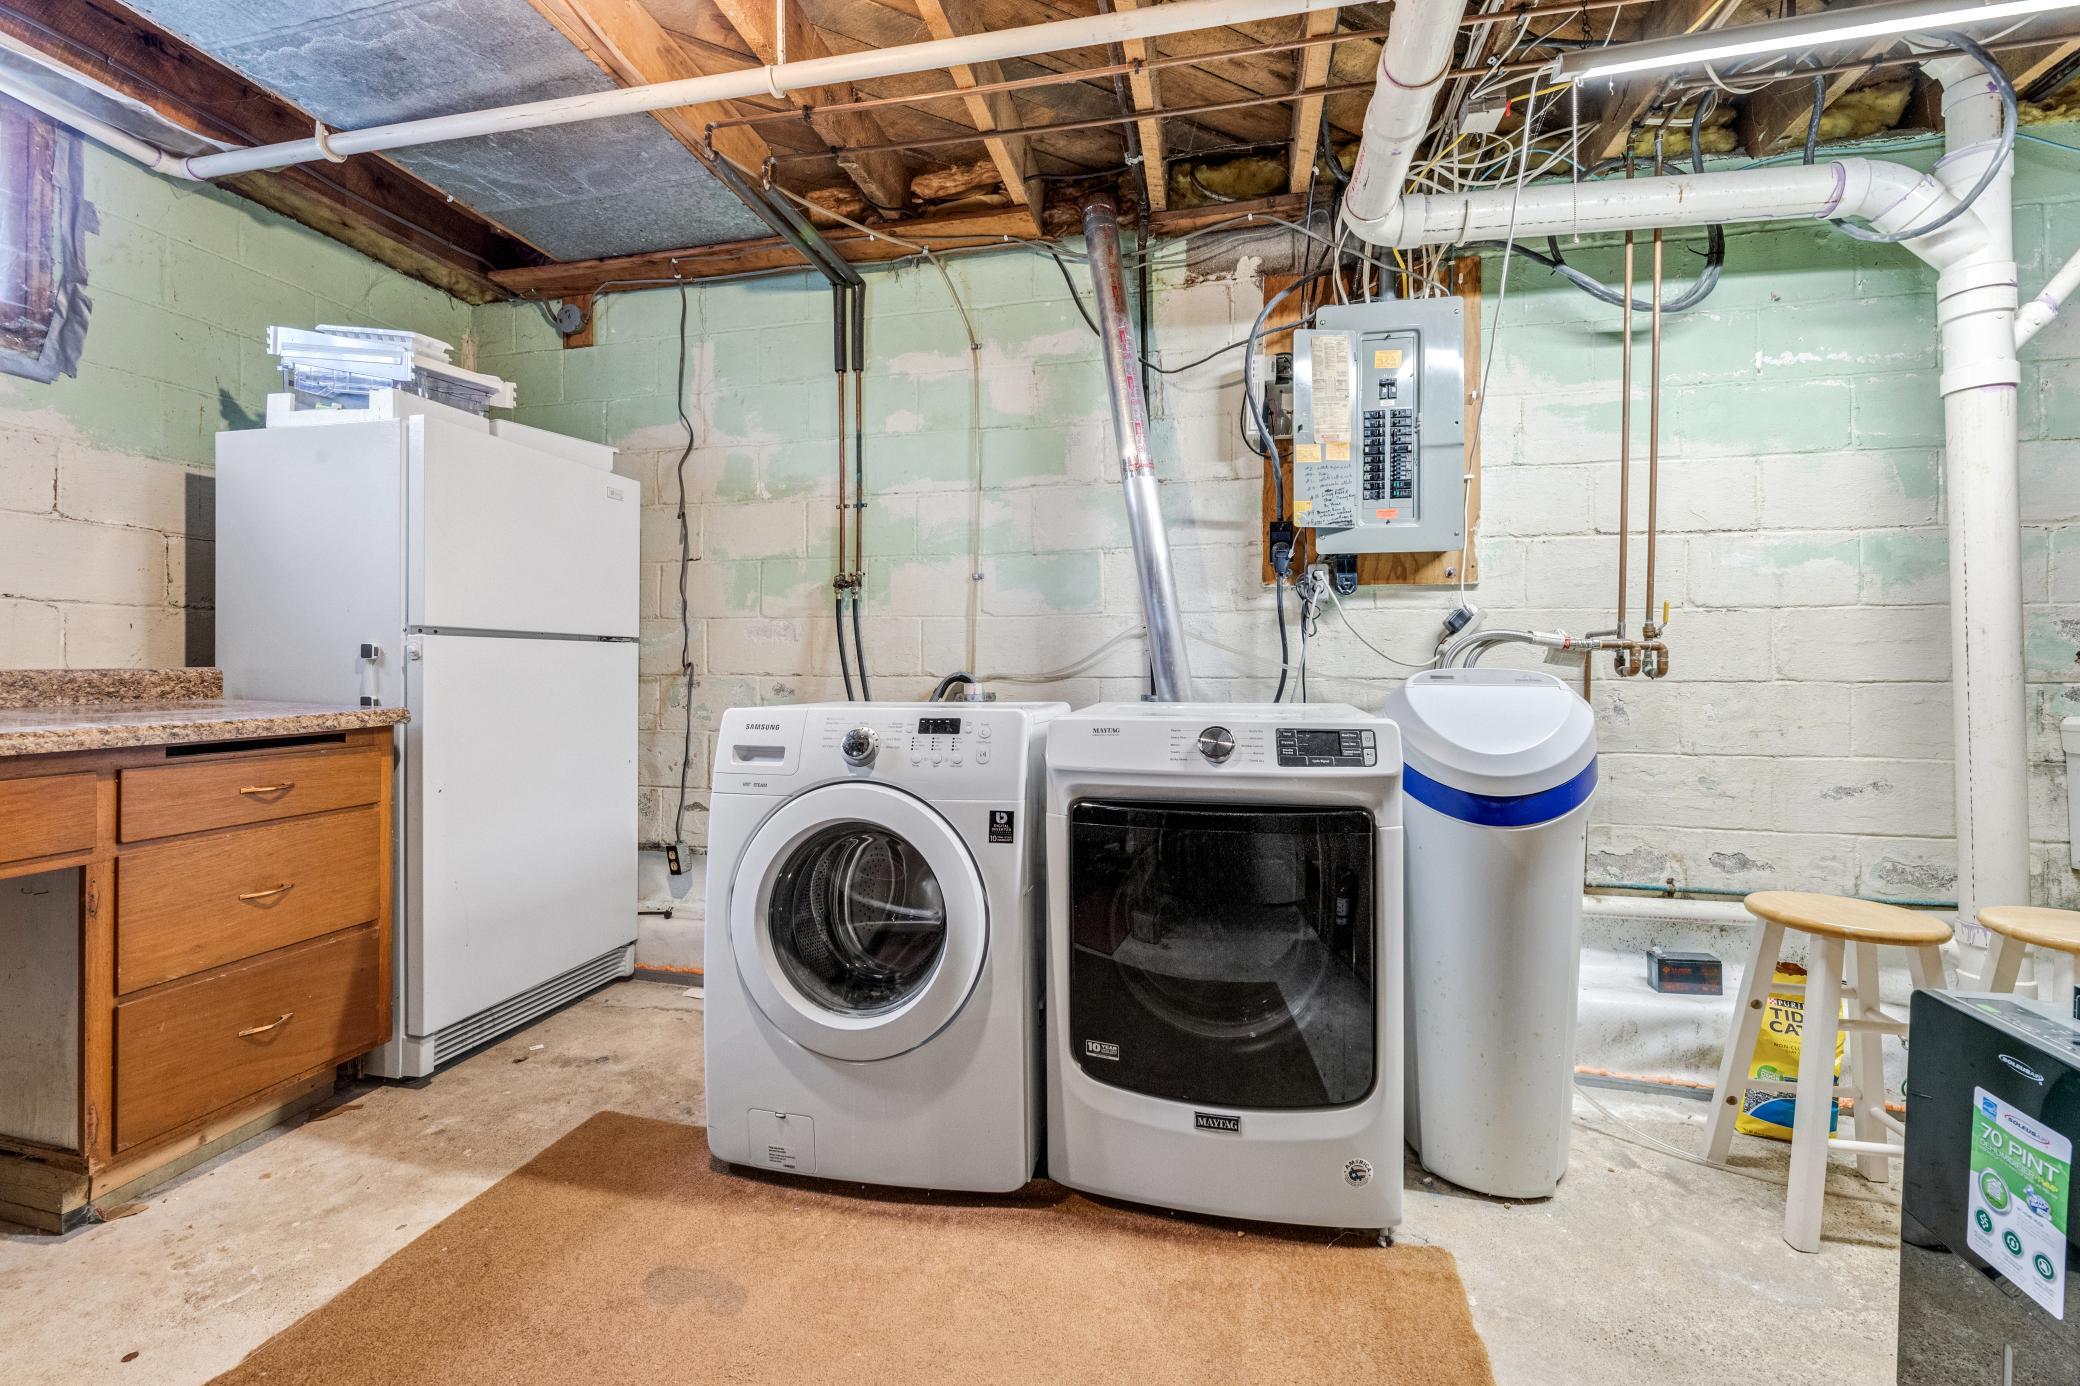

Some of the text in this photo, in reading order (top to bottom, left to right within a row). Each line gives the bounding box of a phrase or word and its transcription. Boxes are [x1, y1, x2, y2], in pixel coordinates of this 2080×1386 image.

[745, 723, 780, 731] SAMSUNG
[1777, 1000, 1803, 1010] PURI
[1769, 1006, 1804, 1023] TID
[1088, 1041, 1100, 1052] 10
[1197, 1116, 1238, 1130] MAYTAG
[1981, 1122, 2002, 1148] 70
[2008, 1140, 2060, 1182] PINT
